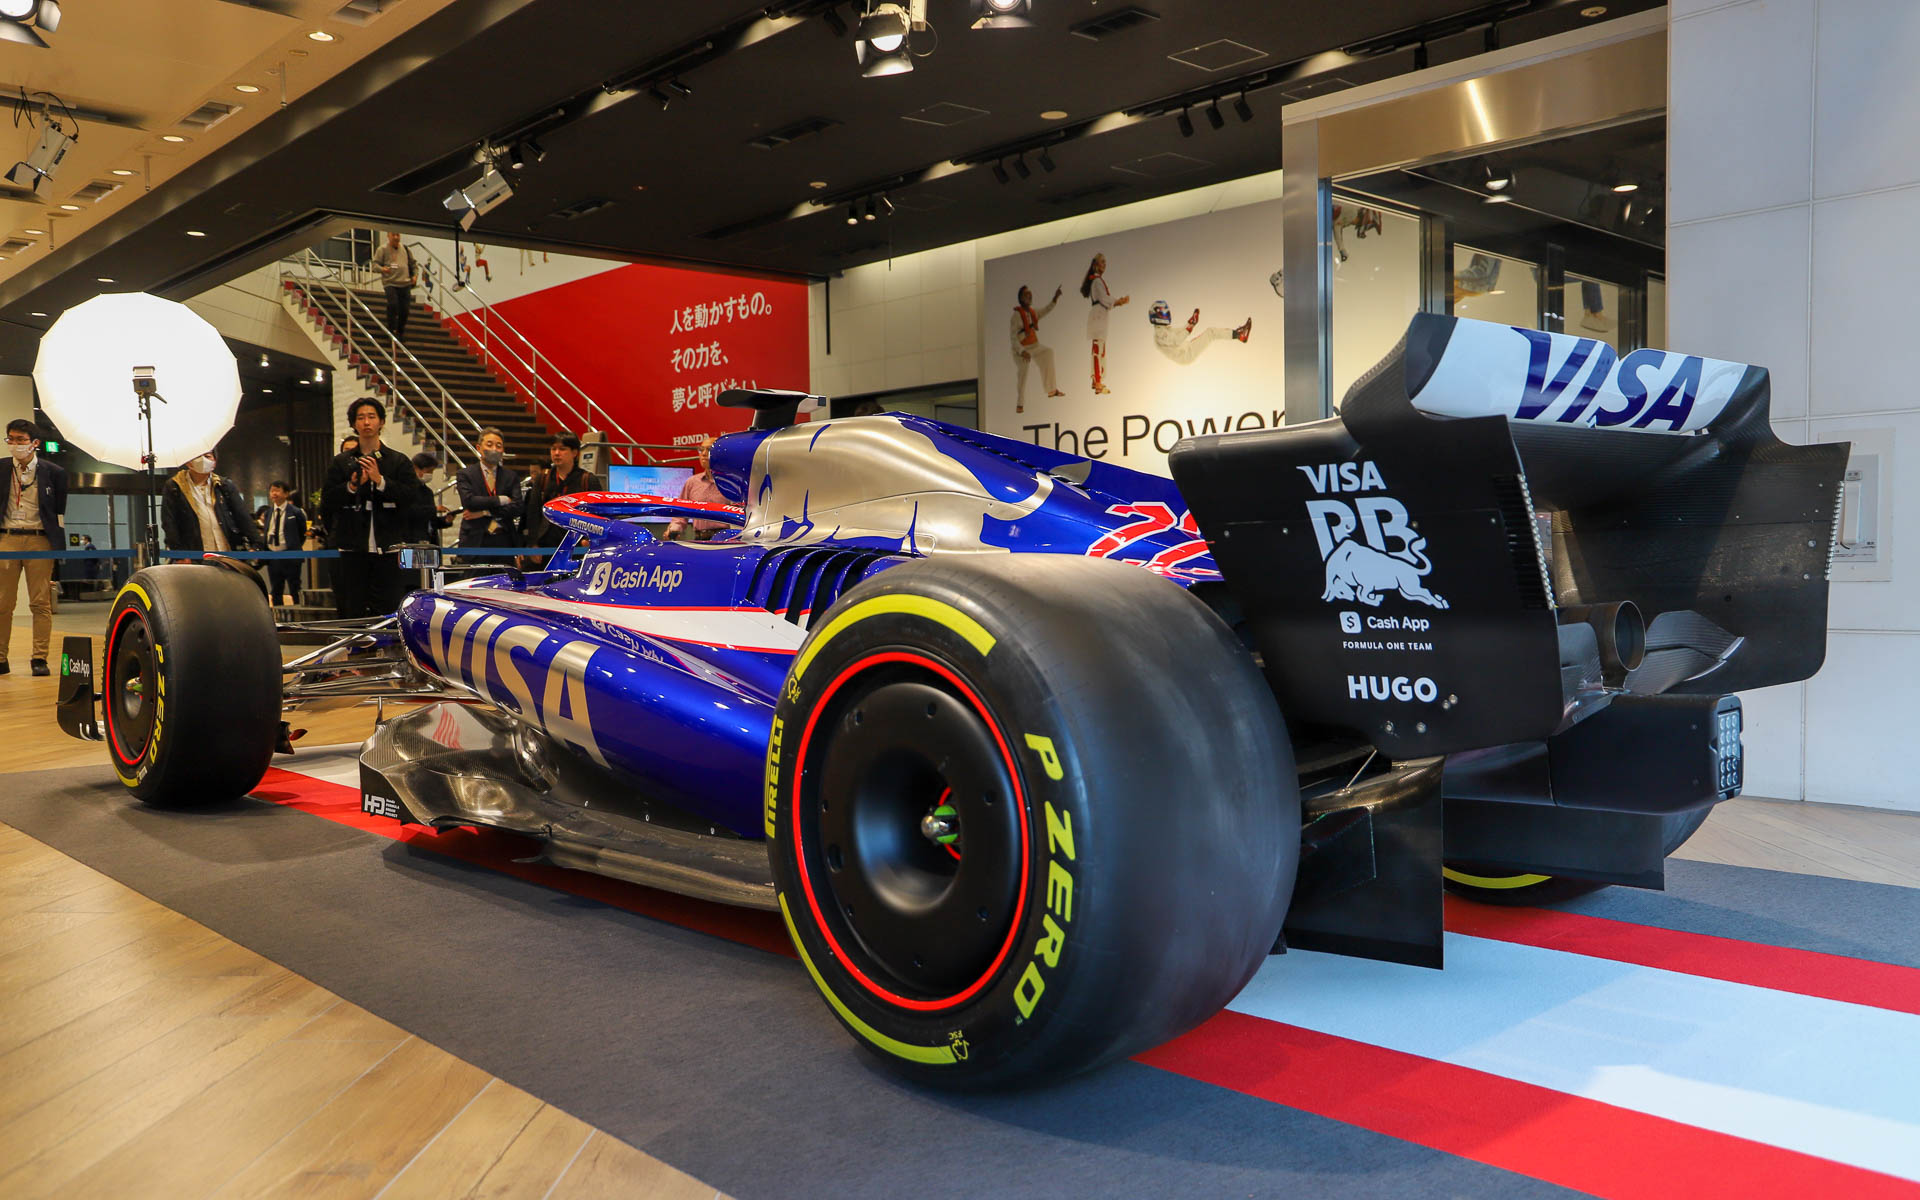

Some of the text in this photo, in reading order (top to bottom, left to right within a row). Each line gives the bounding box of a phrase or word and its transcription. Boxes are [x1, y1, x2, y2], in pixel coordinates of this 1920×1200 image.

[669, 291, 773, 335] 人を動かすもの。
[670, 340, 729, 373] その力を、
[1510, 326, 1703, 431] VISA
[1022, 422, 1109, 459] The
[1296, 460, 1387, 493] VISA
[611, 566, 648, 589] Cash
[648, 565, 683, 593] App
[1367, 615, 1400, 630] Cash
[1402, 616, 1430, 632] App
[1342, 641, 1433, 650] FORMULA ONE TEAM
[69, 658, 81, 674] Cash
[80, 659, 91, 677] App
[430, 598, 613, 770] VISA
[149, 643, 166, 765] P ZERO
[1347, 675, 1438, 703] HUGO
[764, 713, 785, 839] PIRELLI
[1013, 733, 1076, 1019] P ZERO
